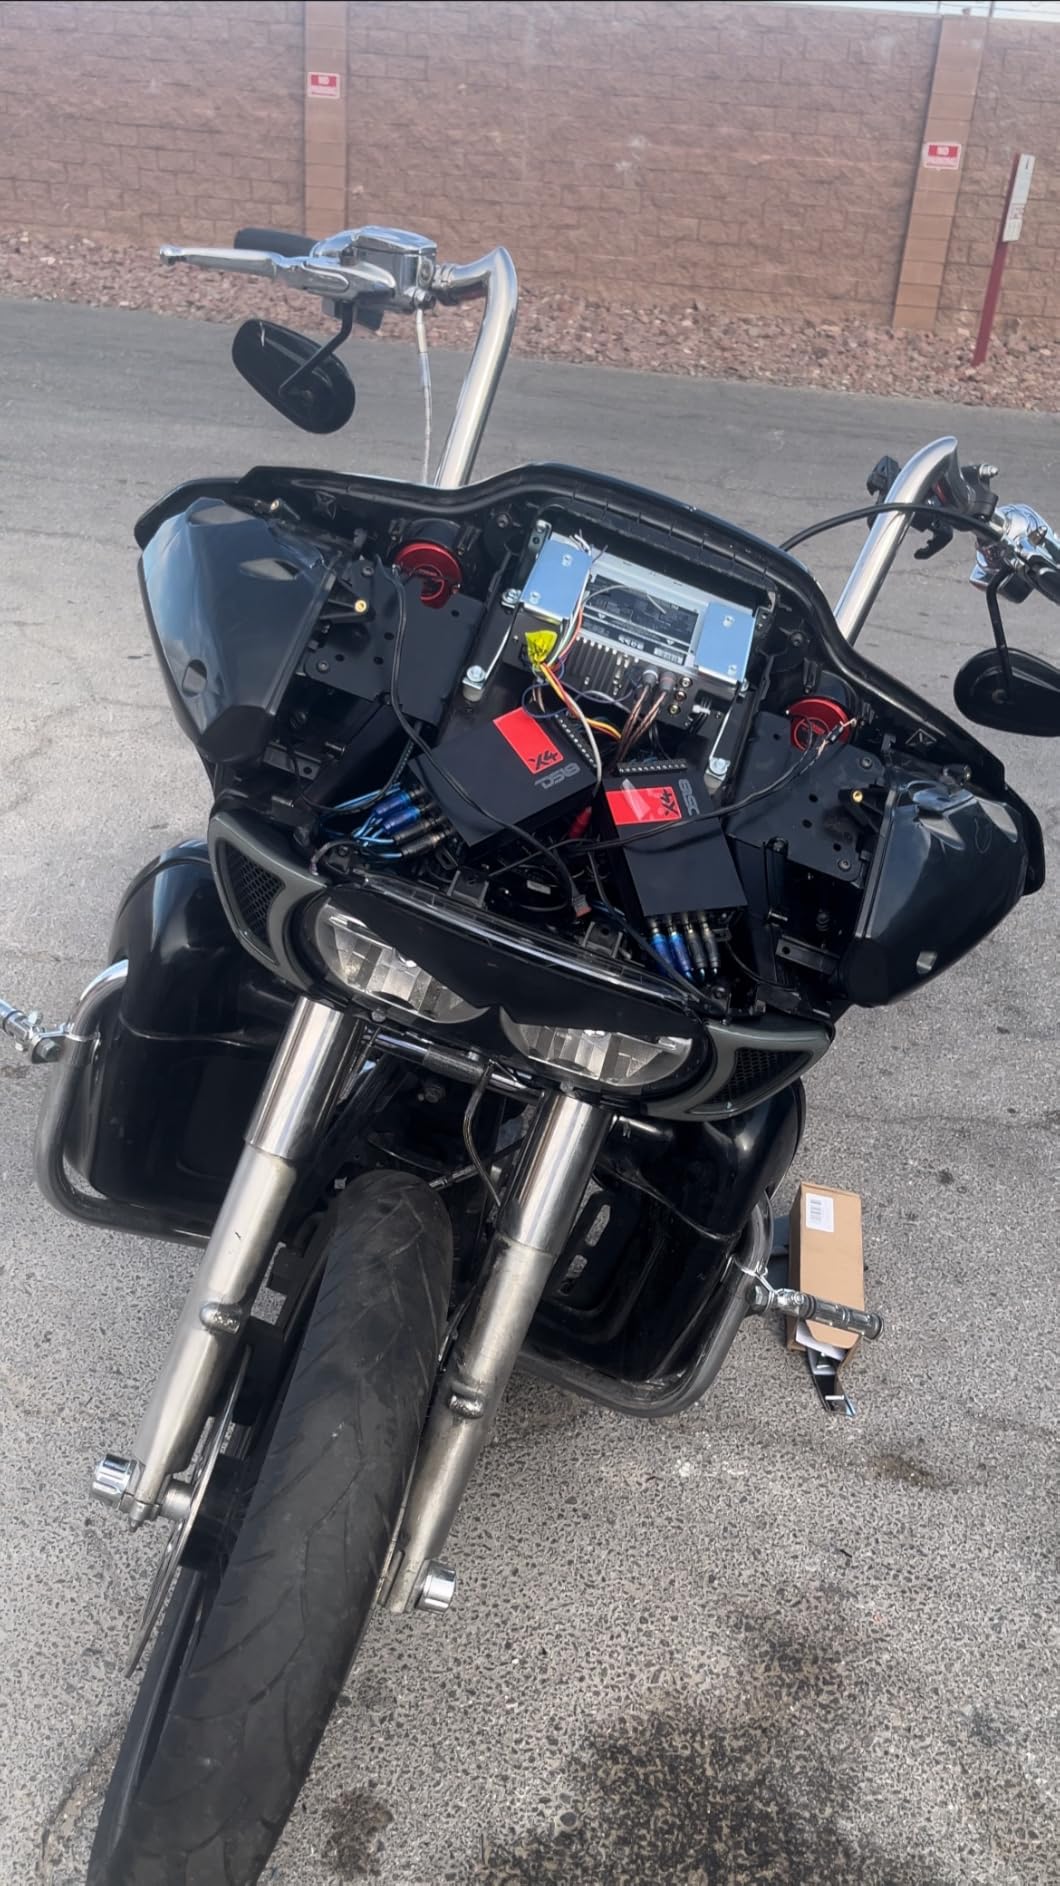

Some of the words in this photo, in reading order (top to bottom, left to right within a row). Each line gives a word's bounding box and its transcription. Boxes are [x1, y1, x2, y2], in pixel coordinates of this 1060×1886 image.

[527, 750, 559, 771] X4
[534, 762, 581, 789] DS18
[660, 788, 680, 817] X4
